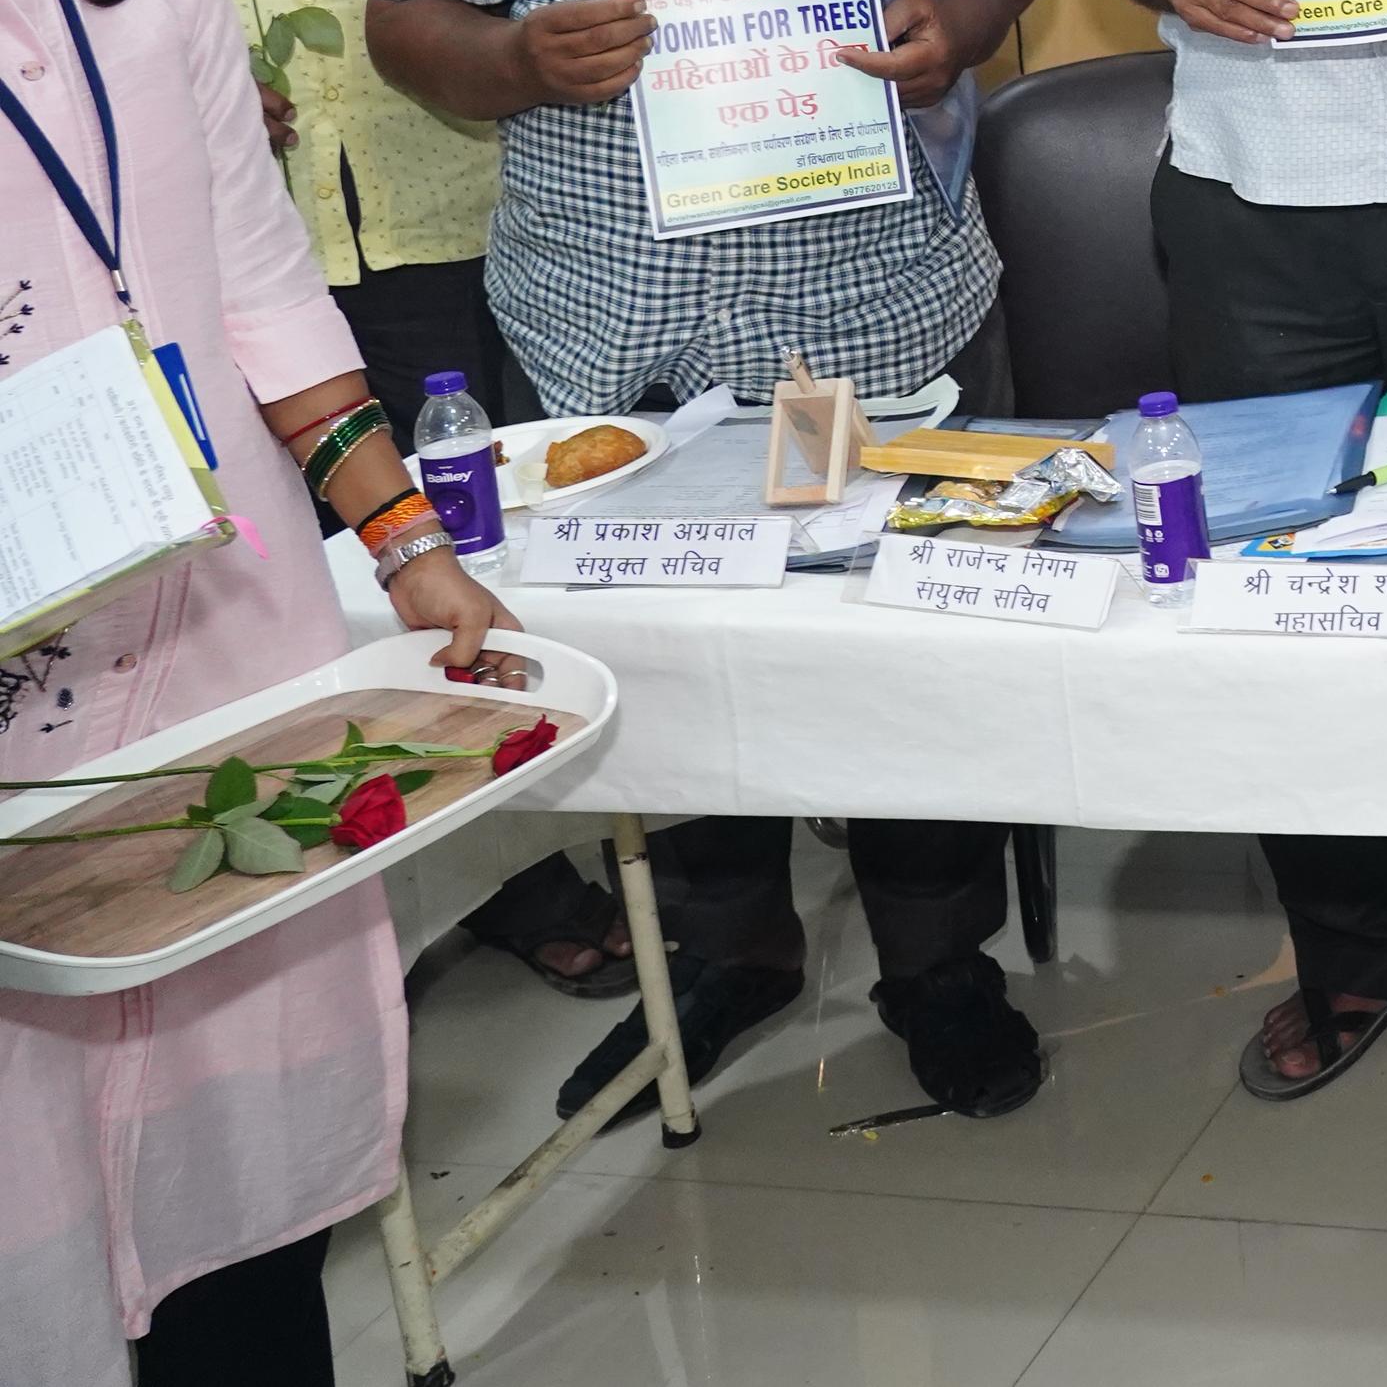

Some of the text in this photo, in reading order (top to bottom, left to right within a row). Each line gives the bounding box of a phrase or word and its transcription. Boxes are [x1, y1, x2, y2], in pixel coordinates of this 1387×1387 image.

[742, 8, 792, 42] FOR
[665, 159, 891, 210] Green Care Society India
[554, 518, 757, 541] श्री प्रकाश अग्रवाल
[576, 550, 723, 582] संयुक्त सचिव
[909, 540, 1079, 578] श्री राजेन्द्र निगम
[917, 576, 1052, 612] संयुक्त सचिव
[1244, 569, 1271, 594] श्री
[1287, 568, 1359, 594] चन्द्रेश
[1275, 605, 1383, 633] महासचिव
